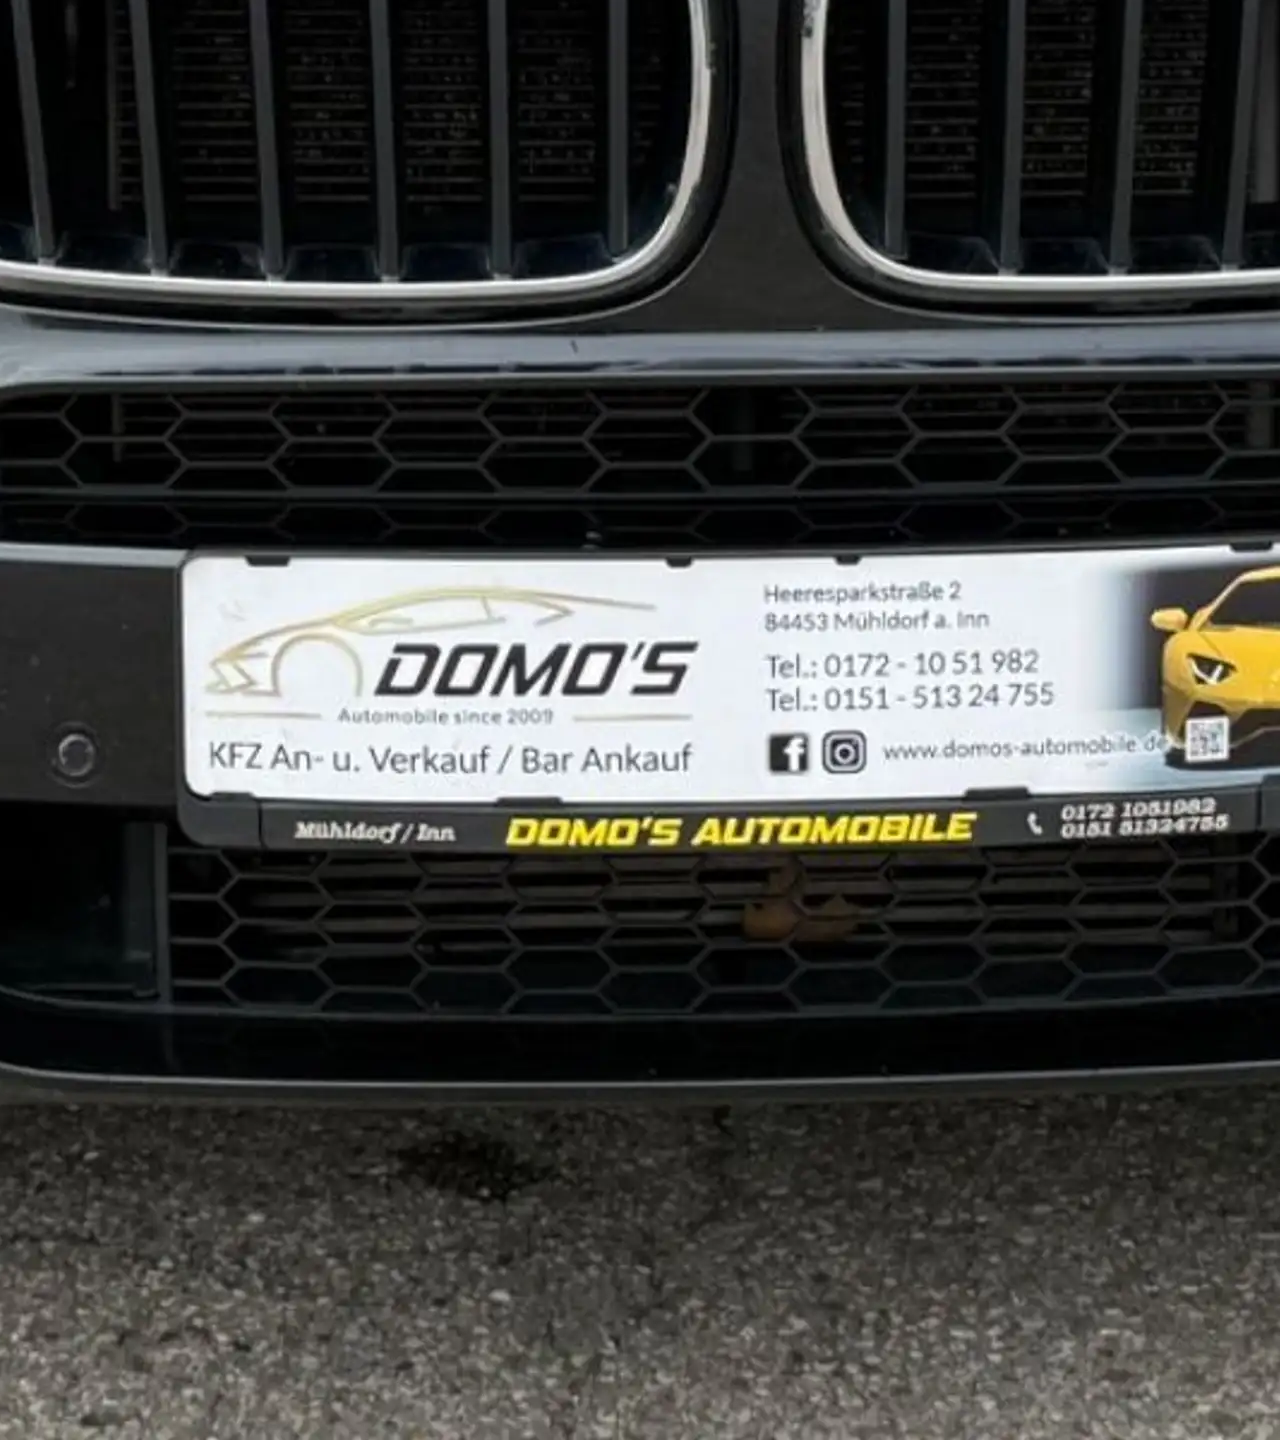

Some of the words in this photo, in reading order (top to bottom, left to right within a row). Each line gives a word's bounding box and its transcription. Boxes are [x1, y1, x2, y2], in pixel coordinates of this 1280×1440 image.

[764, 580, 945, 605] Heeresparkstraße
[949, 581, 962, 600] 2
[764, 612, 827, 631] 84453
[833, 609, 929, 631] Mühldorf
[934, 613, 952, 629] a.
[957, 612, 990, 628] Inn
[374, 641, 699, 698] DOMO'S
[766, 653, 817, 679] Tel.:
[824, 652, 890, 677] 0172
[915, 651, 945, 675] 10
[952, 650, 983, 674] 51
[991, 648, 1040, 673] 982
[766, 687, 817, 712] Tel.:
[824, 686, 890, 710] 0151
[913, 685, 962, 708] 513
[969, 684, 1000, 707] 24
[1007, 682, 1055, 706] 755
[337, 708, 449, 725] Automobile
[453, 708, 503, 724] since
[208, 742, 263, 769] KFZ
[270, 743, 324, 770] An-
[332, 751, 361, 773] u.
[369, 745, 491, 774] Verkauf
[521, 747, 573, 774] Bar
[580, 743, 693, 773] Ankauf
[882, 729, 1169, 760] www.domos-automoblede
[1061, 803, 1115, 822] 0172
[506, 816, 684, 847] DOMO'S
[691, 813, 978, 846] AUTOMOBILE
